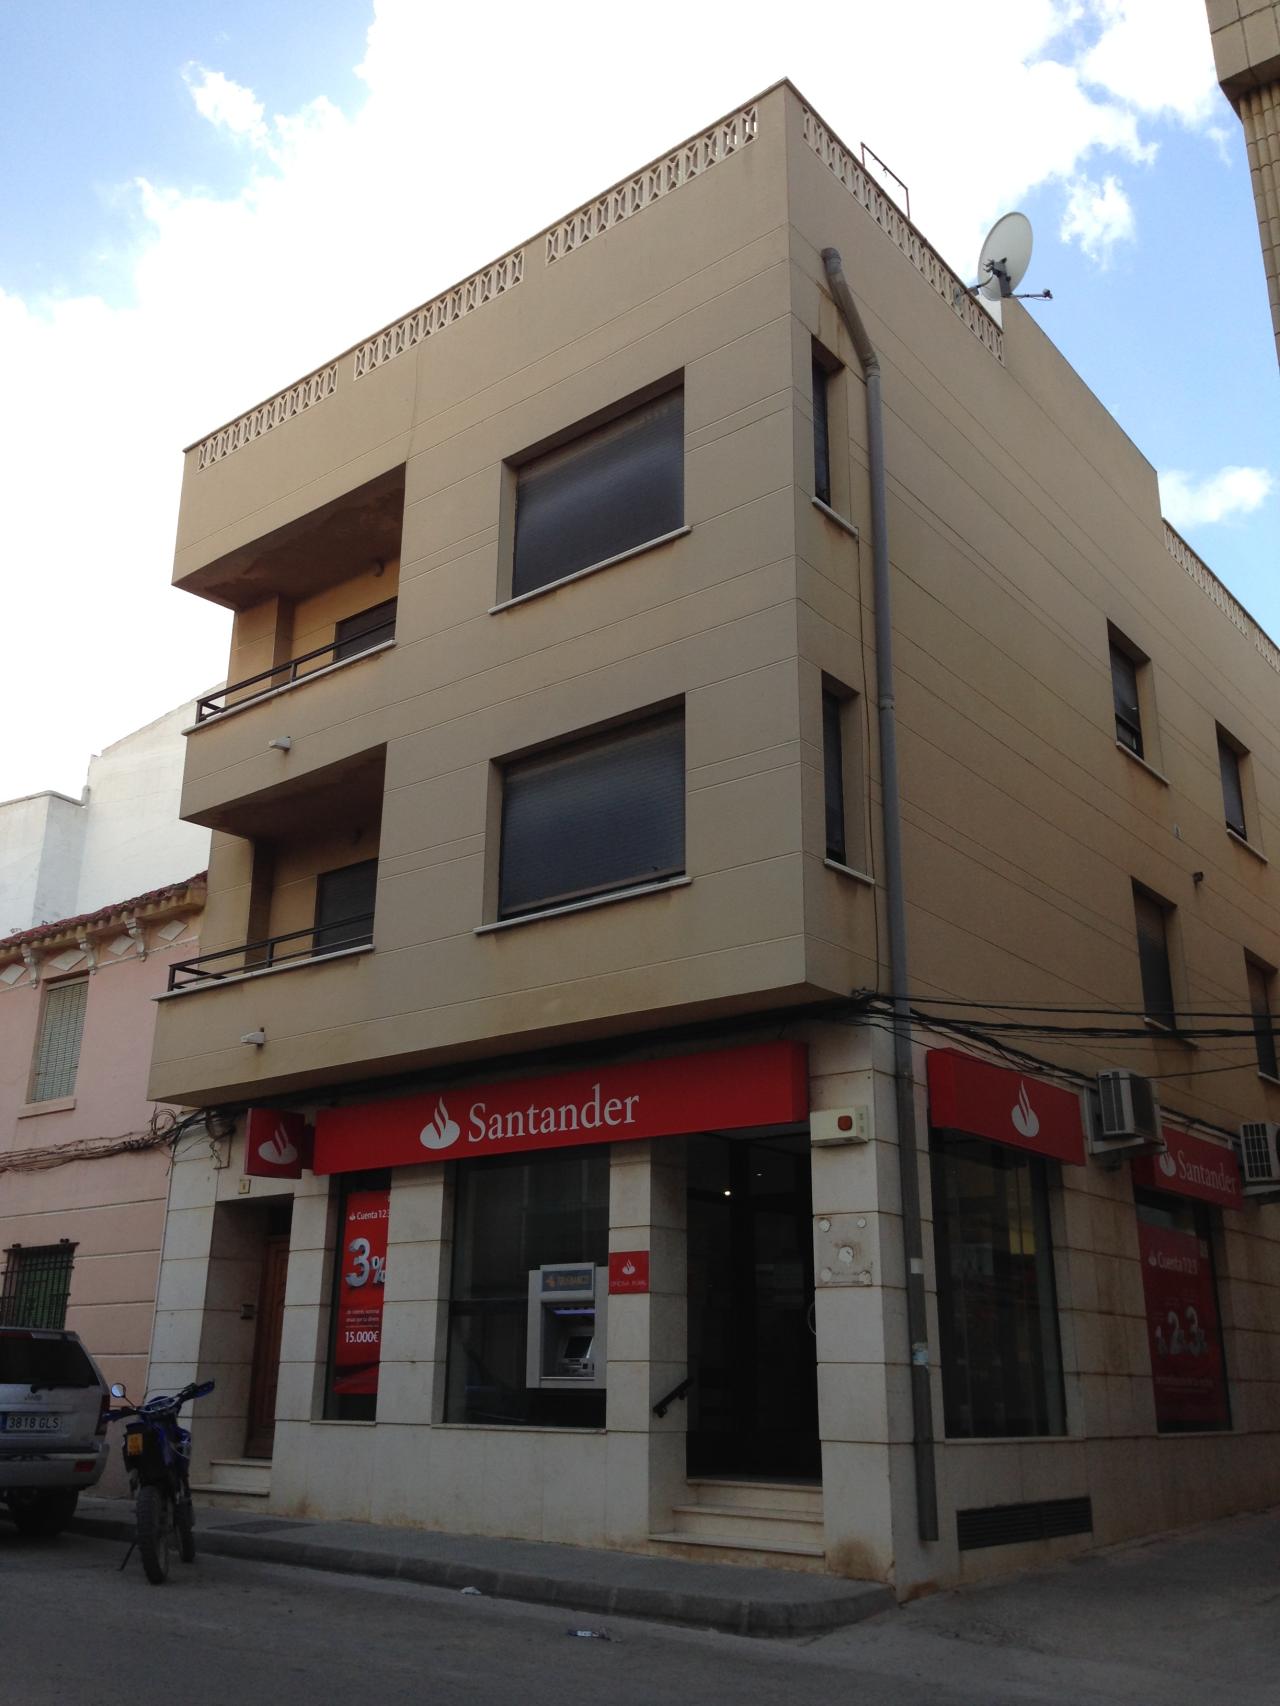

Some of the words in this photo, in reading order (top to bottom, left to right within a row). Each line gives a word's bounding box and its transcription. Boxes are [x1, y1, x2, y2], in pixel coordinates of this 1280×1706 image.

[468, 1082, 640, 1143] Santander
[1177, 1150, 1237, 1193] Santander
[356, 1210, 378, 1220] Cuenta
[345, 1330, 380, 1343] 15.000€
[9, 1417, 36, 1429] 3818
[39, 1417, 59, 1429] GLS
